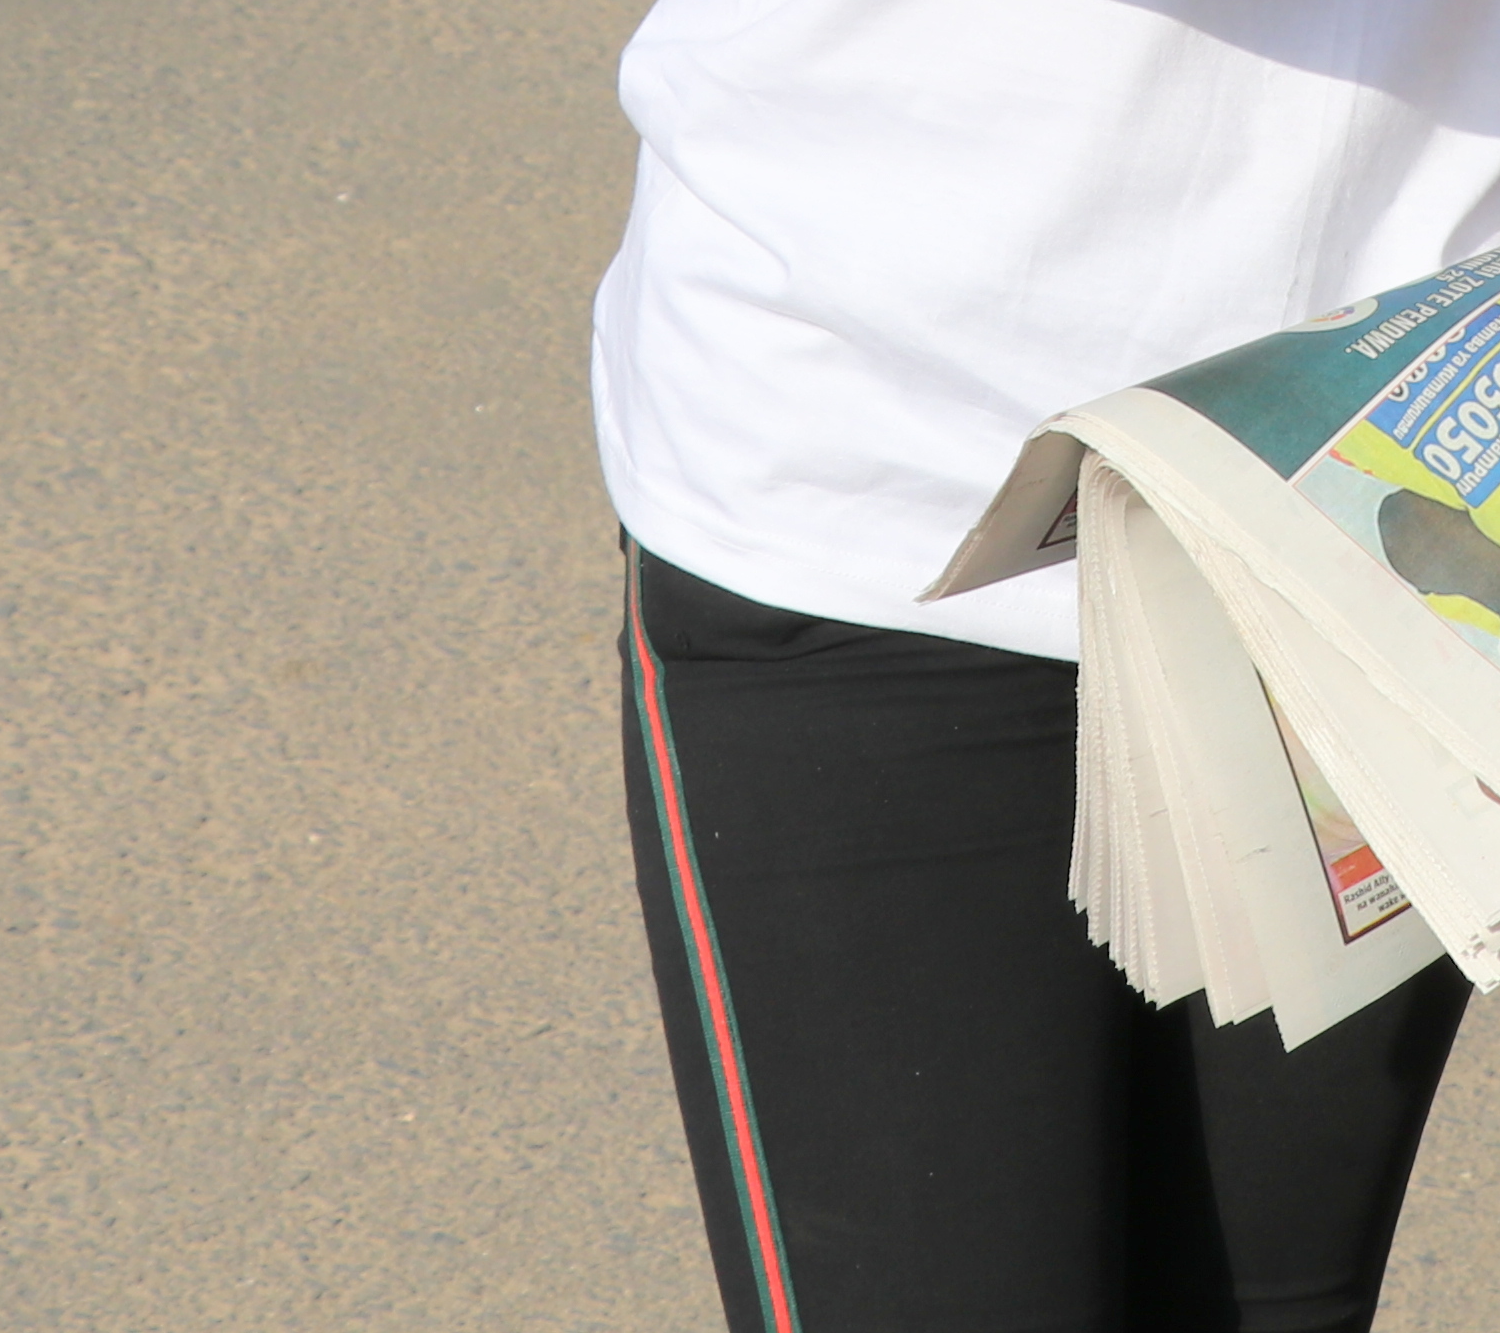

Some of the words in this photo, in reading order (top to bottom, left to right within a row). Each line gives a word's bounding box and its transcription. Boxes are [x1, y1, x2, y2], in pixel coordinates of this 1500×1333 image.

[1424, 274, 1484, 306] ZOTE
[1343, 302, 1442, 359] PENDWA.
[1342, 882, 1372, 903] Rashid
[1372, 873, 1390, 888] Ally
[1356, 899, 1368, 911] na
